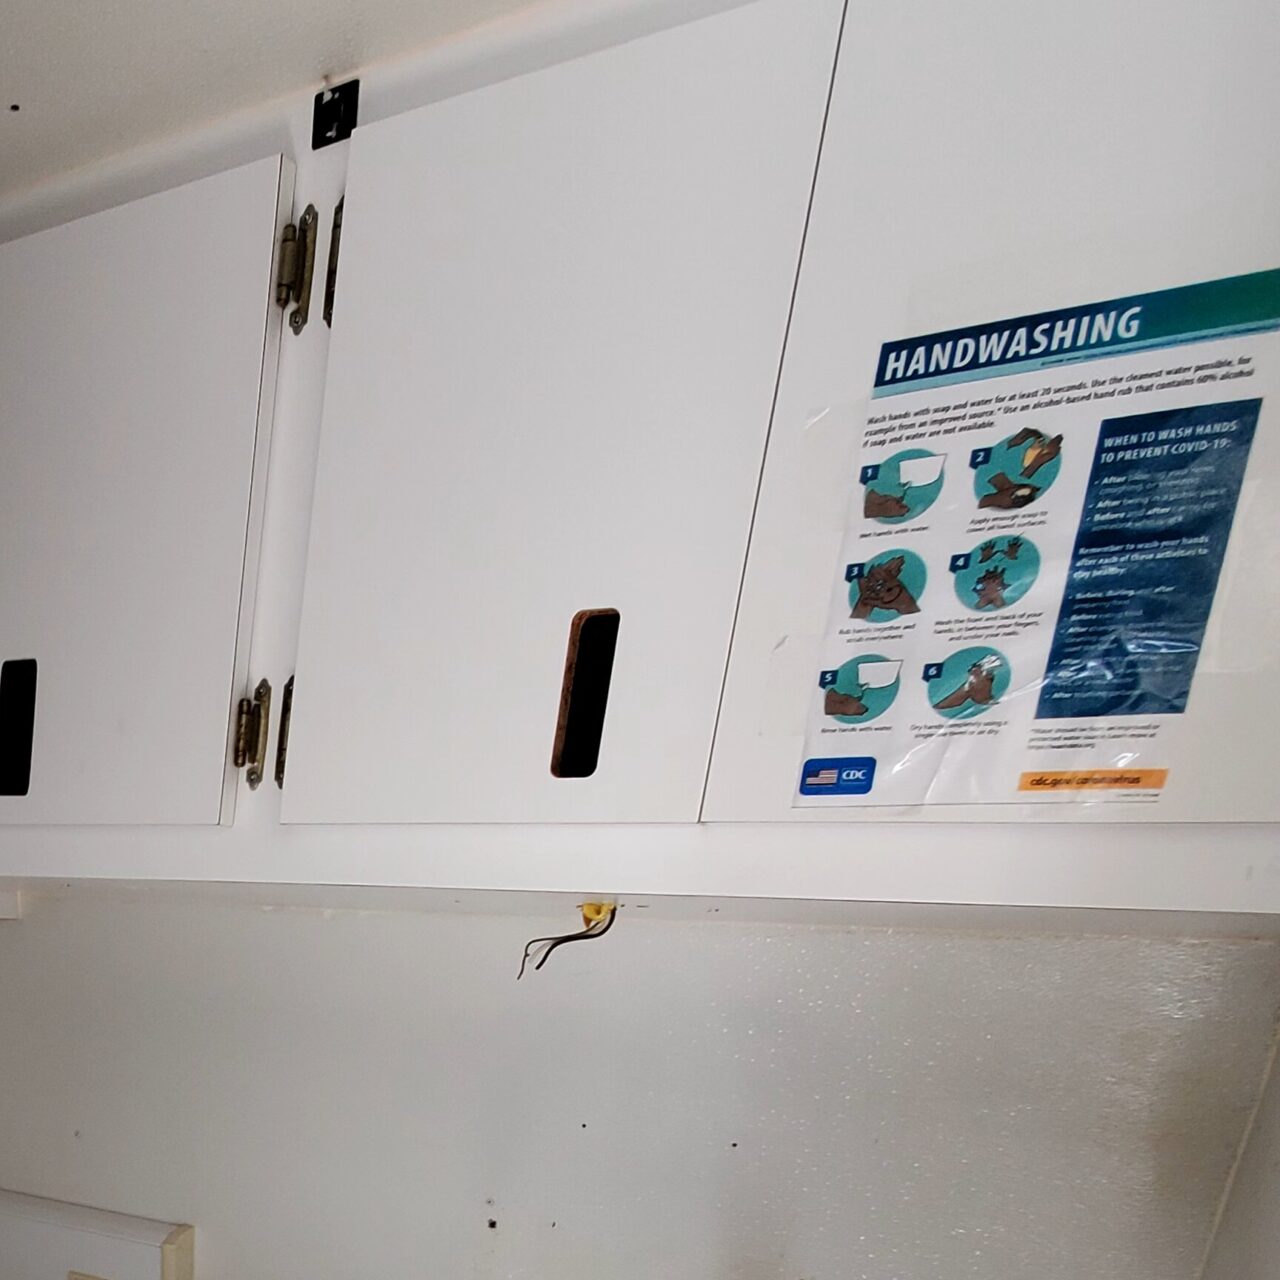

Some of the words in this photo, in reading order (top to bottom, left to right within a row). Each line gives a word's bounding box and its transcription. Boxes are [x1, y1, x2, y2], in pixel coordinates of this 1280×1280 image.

[883, 306, 1142, 381] HANDWASHING
[888, 411, 911, 421] hands
[913, 406, 930, 417] with
[932, 405, 951, 414] soap
[952, 401, 968, 411] and
[970, 398, 993, 408] water
[994, 395, 1006, 404] for
[1018, 389, 1039, 400] least
[1040, 387, 1051, 396] 20
[1091, 379, 1107, 388] Use
[1109, 376, 1123, 384] the
[1125, 370, 1163, 383] cleanest
[1165, 365, 1192, 376] water
[1237, 356, 1252, 365] for
[929, 412, 967, 426] improved
[1003, 406, 1018, 414] Use
[1093, 388, 1115, 399] hand
[1117, 386, 1133, 396] rub
[1135, 383, 1154, 393] that
[1155, 377, 1194, 390] contains
[1219, 368, 1255, 381] alcohol
[888, 434, 903, 444] and
[905, 431, 927, 440] water
[942, 426, 957, 435] not
[1104, 434, 1140, 448] WHEN
[1141, 431, 1156, 442] TO
[1158, 427, 1193, 440] WASH
[1195, 420, 1239, 435] HANDS
[976, 452, 984, 462] 2
[1101, 452, 1114, 464] TO
[1116, 445, 1169, 462] PREVENT
[955, 557, 964, 566] 4
[851, 567, 858, 575] 3
[825, 673, 832, 682] 5
[928, 667, 937, 676] 6
[842, 769, 867, 781] CDC
